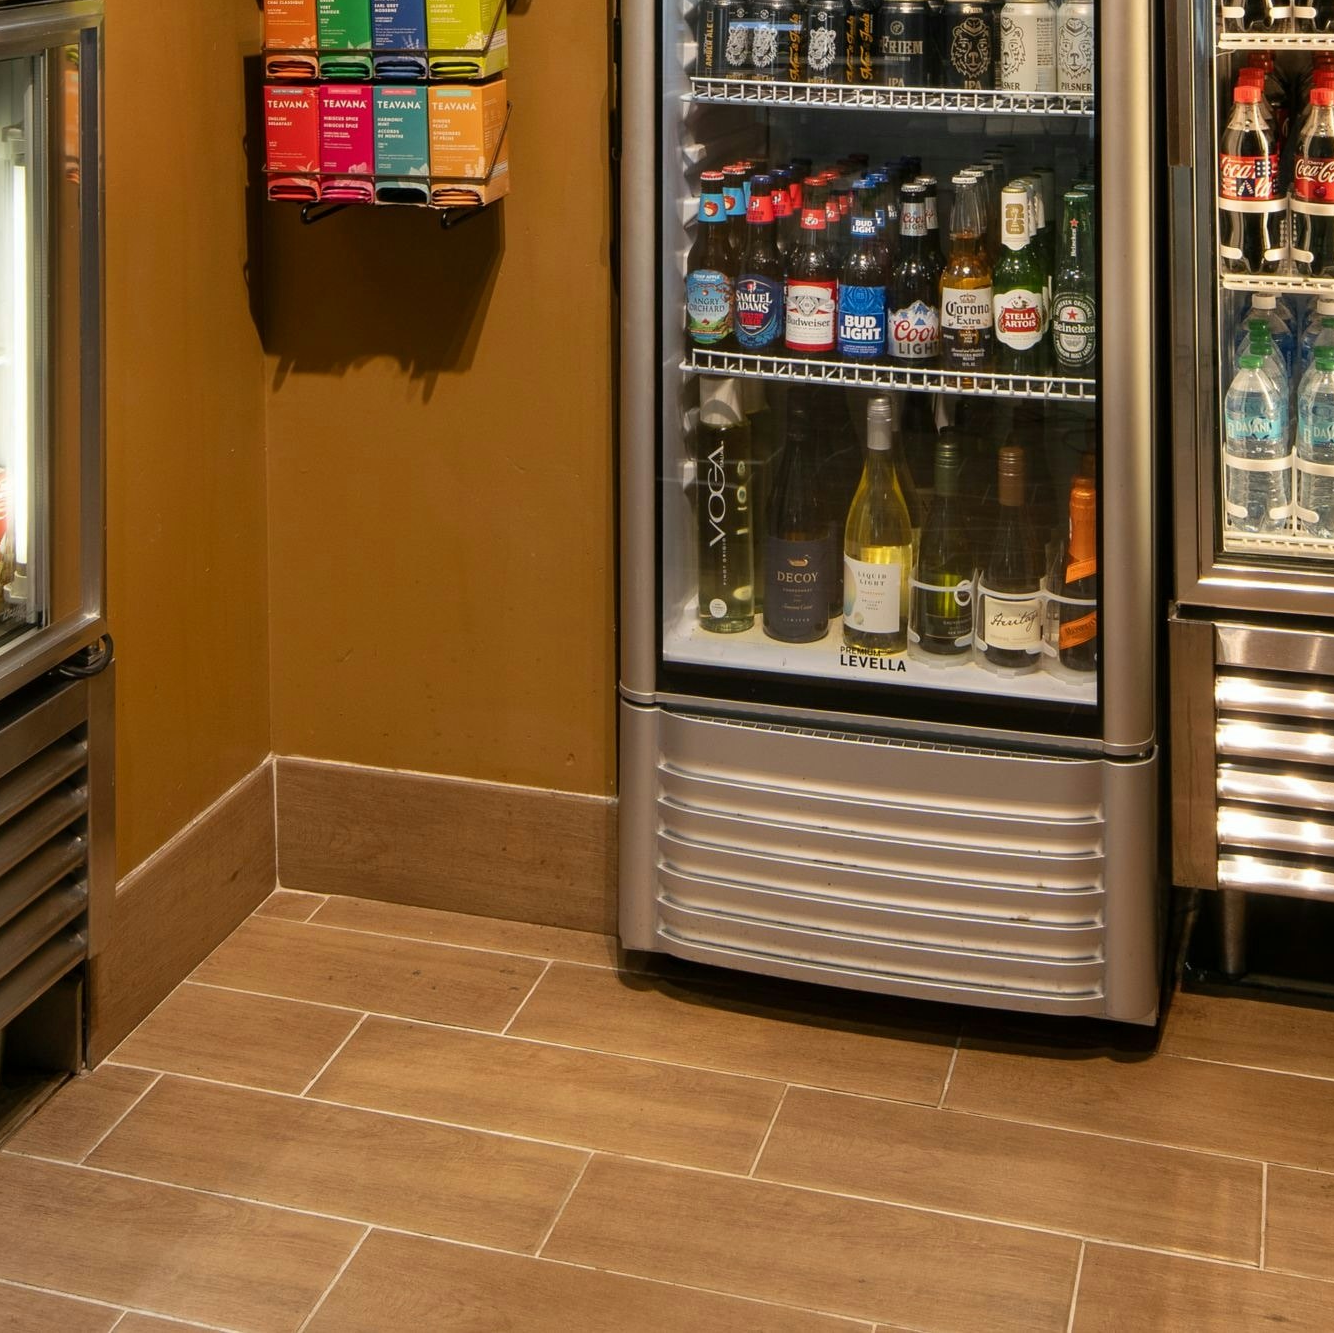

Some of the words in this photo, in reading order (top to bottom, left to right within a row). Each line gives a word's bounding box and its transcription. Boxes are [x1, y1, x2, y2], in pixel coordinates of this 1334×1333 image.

[887, 77, 905, 88] IPA
[964, 80, 982, 90] IPA
[1060, 81, 1093, 91] PILSNER
[267, 100, 310, 109] TEAVANA
[323, 99, 367, 109] TEAVANA
[377, 100, 422, 109] TEAVANA
[432, 102, 478, 111] TEAVANA
[852, 225, 876, 234] LIGHT
[736, 290, 773, 304] SAMUEL
[689, 304, 725, 313] ORCHARD
[736, 301, 770, 314] ADAMS
[945, 300, 990, 316] Corona
[786, 314, 831, 328] Budweiser
[844, 314, 877, 328] BUD
[954, 315, 982, 325] Extra
[1004, 312, 1036, 321] STELLA
[1004, 319, 1037, 329] ARTOIS
[1053, 321, 1096, 334] Heineken
[840, 326, 882, 341] LIGHT
[898, 342, 938, 355] LIGHT
[707, 444, 727, 548] VOGA
[776, 570, 819, 584] DECOY
[857, 571, 887, 580] LIQUID
[859, 578, 886, 586] LIGHT
[989, 609, 1039, 633] Heritag
[840, 645, 882, 657] PREMIUM
[839, 655, 907, 673] LEVELLA
